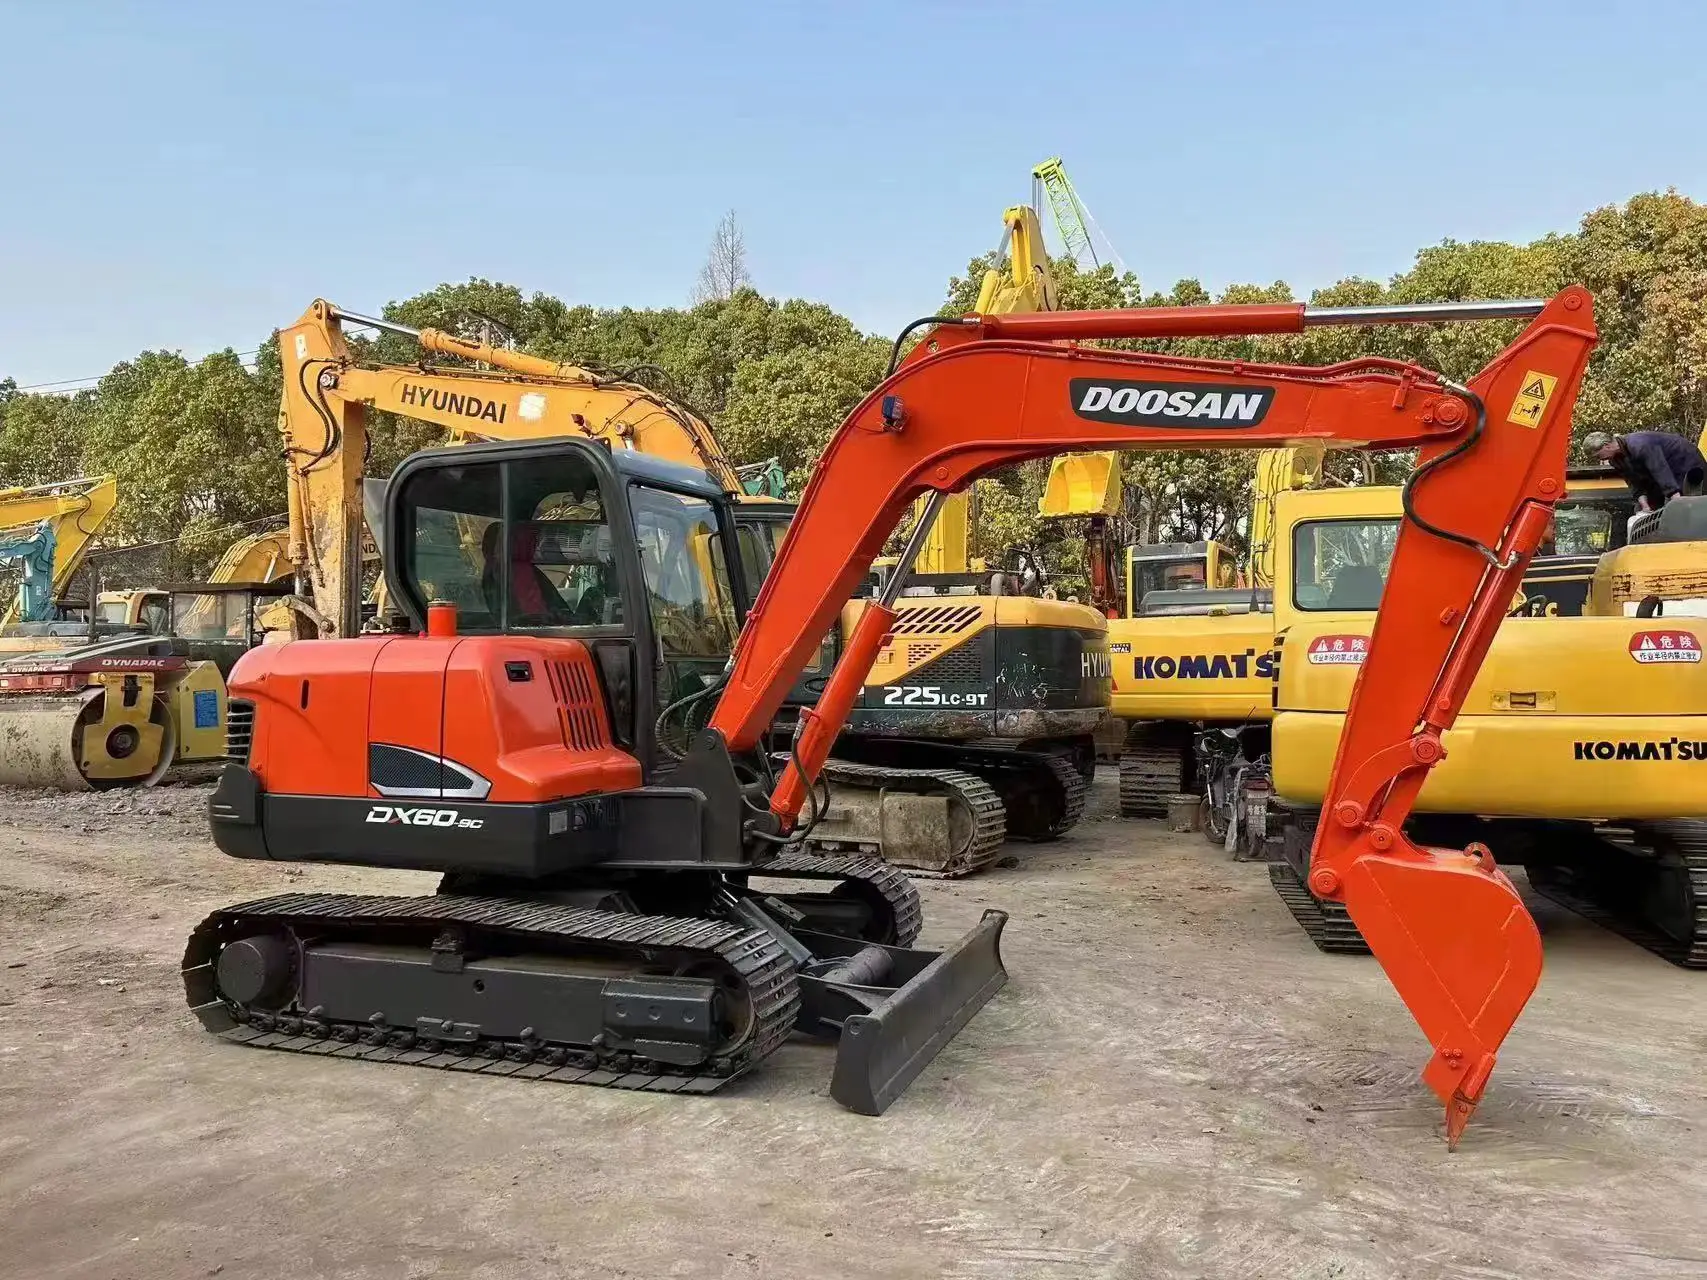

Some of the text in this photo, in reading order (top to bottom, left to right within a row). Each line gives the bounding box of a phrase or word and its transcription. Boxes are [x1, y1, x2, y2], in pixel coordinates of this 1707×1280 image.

[400, 383, 507, 424] HYUNDAI
[1079, 386, 1263, 420] DOOSAN
[102, 659, 166, 667] DYNAPAC
[1574, 737, 1707, 760] KOMATSU
[366, 806, 484, 829] DX60-9C
